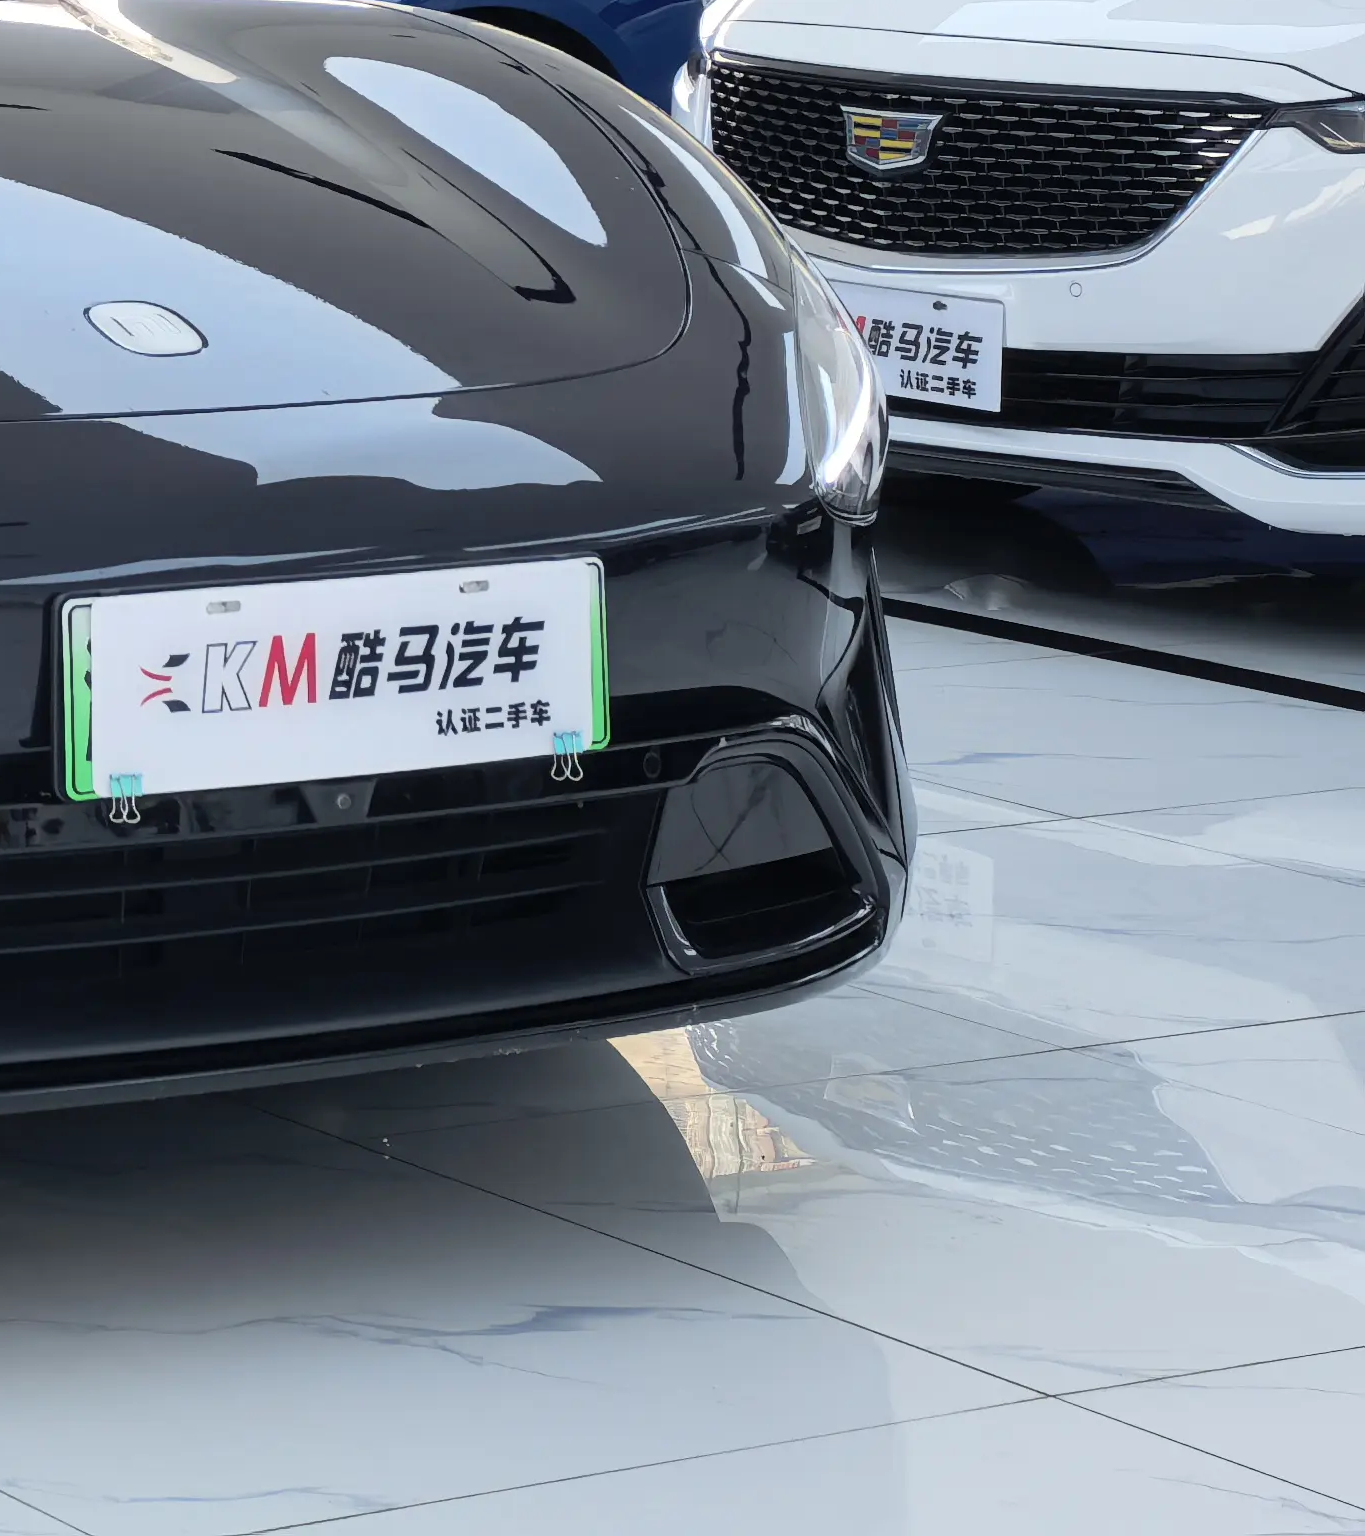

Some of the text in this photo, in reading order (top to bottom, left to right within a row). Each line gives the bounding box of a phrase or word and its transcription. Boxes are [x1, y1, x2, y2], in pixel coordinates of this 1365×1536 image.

[868, 318, 983, 369] 酷马汽车
[900, 369, 977, 399] 认证二手车
[201, 616, 545, 713] KM 酷马汽车
[436, 699, 552, 736] 认证二手车
